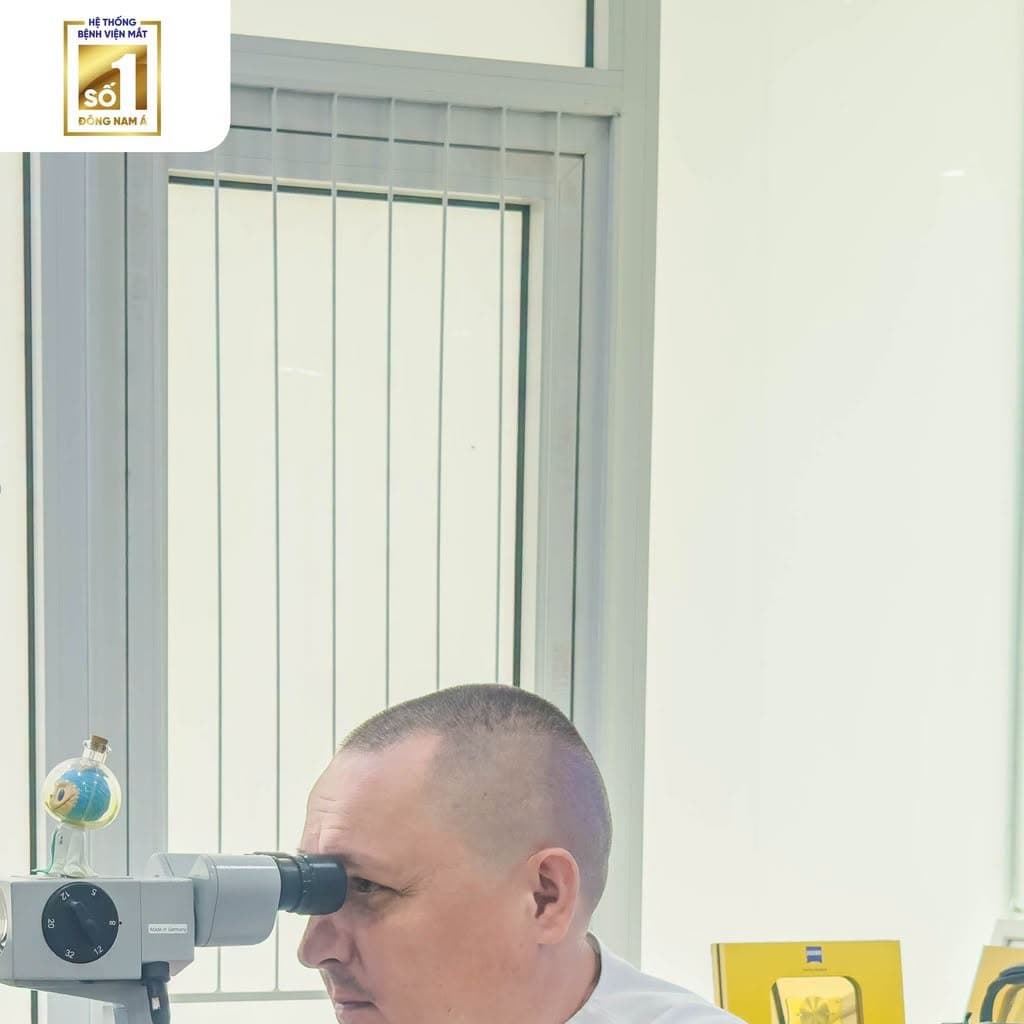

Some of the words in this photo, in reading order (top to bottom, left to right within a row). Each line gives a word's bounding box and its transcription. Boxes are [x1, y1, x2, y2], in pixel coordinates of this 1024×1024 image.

[48, 918, 55, 928] 20
[64, 948, 76, 959] 32
[93, 946, 104, 956] 12
